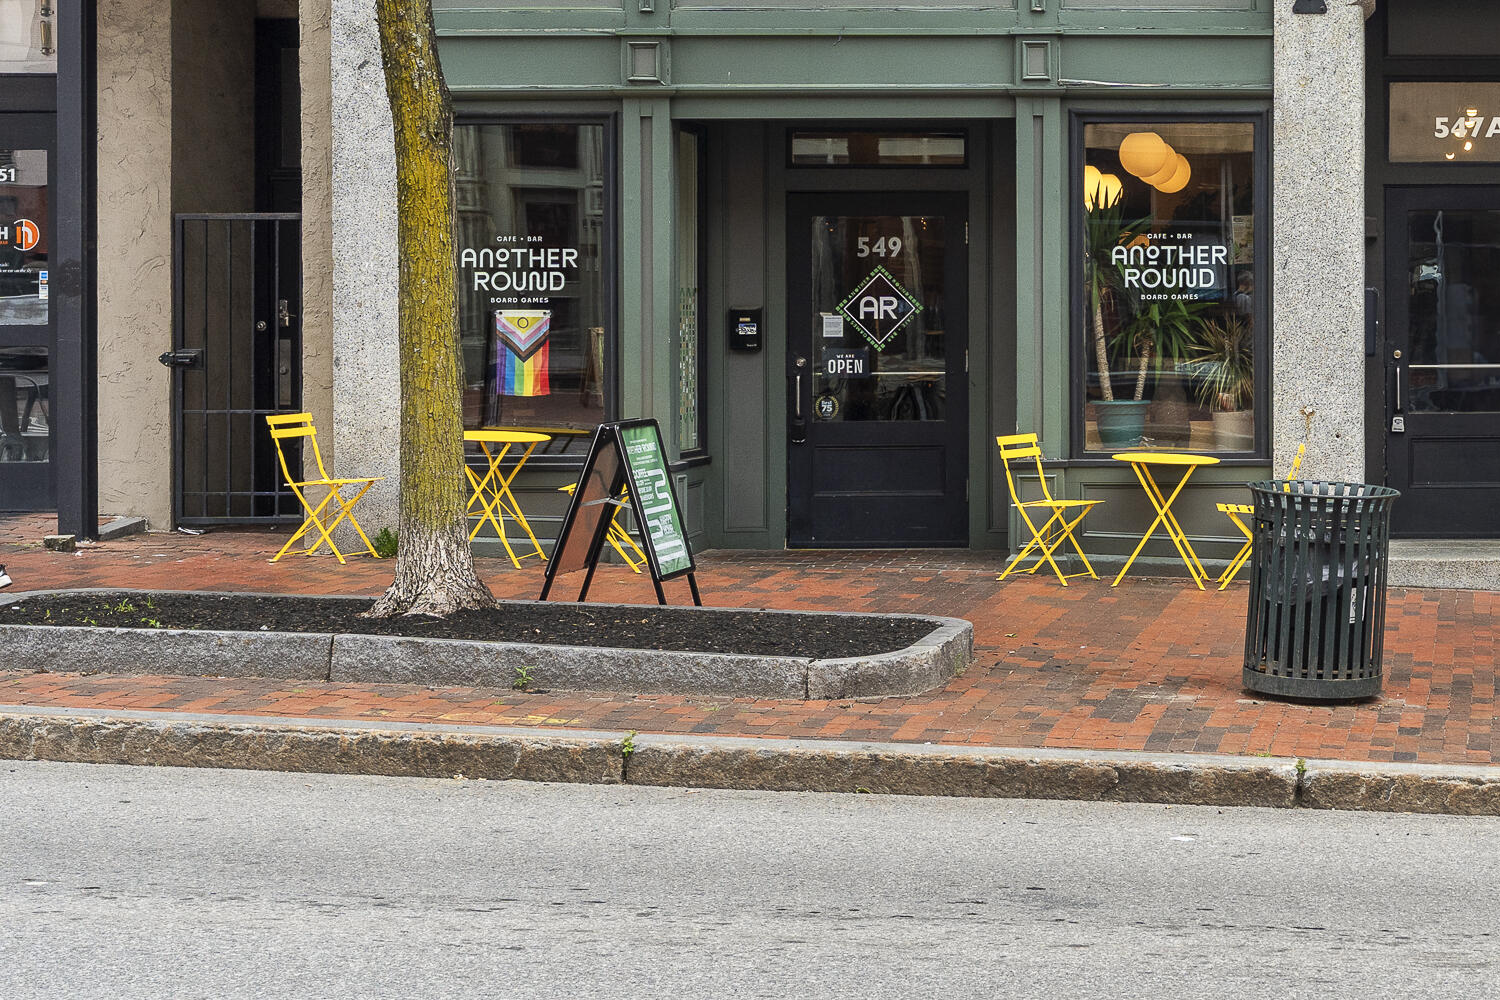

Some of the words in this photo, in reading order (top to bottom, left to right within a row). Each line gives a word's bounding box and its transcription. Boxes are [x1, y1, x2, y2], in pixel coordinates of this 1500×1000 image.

[856, 236, 902, 258] 549
[1111, 245, 1228, 265] ANOTHER
[461, 248, 579, 268] ANOTHER
[474, 271, 566, 291] ROUND
[1124, 268, 1215, 288] ROUND
[859, 296, 898, 320] AR
[828, 359, 863, 374] OPEN
[821, 404, 833, 412] 75
